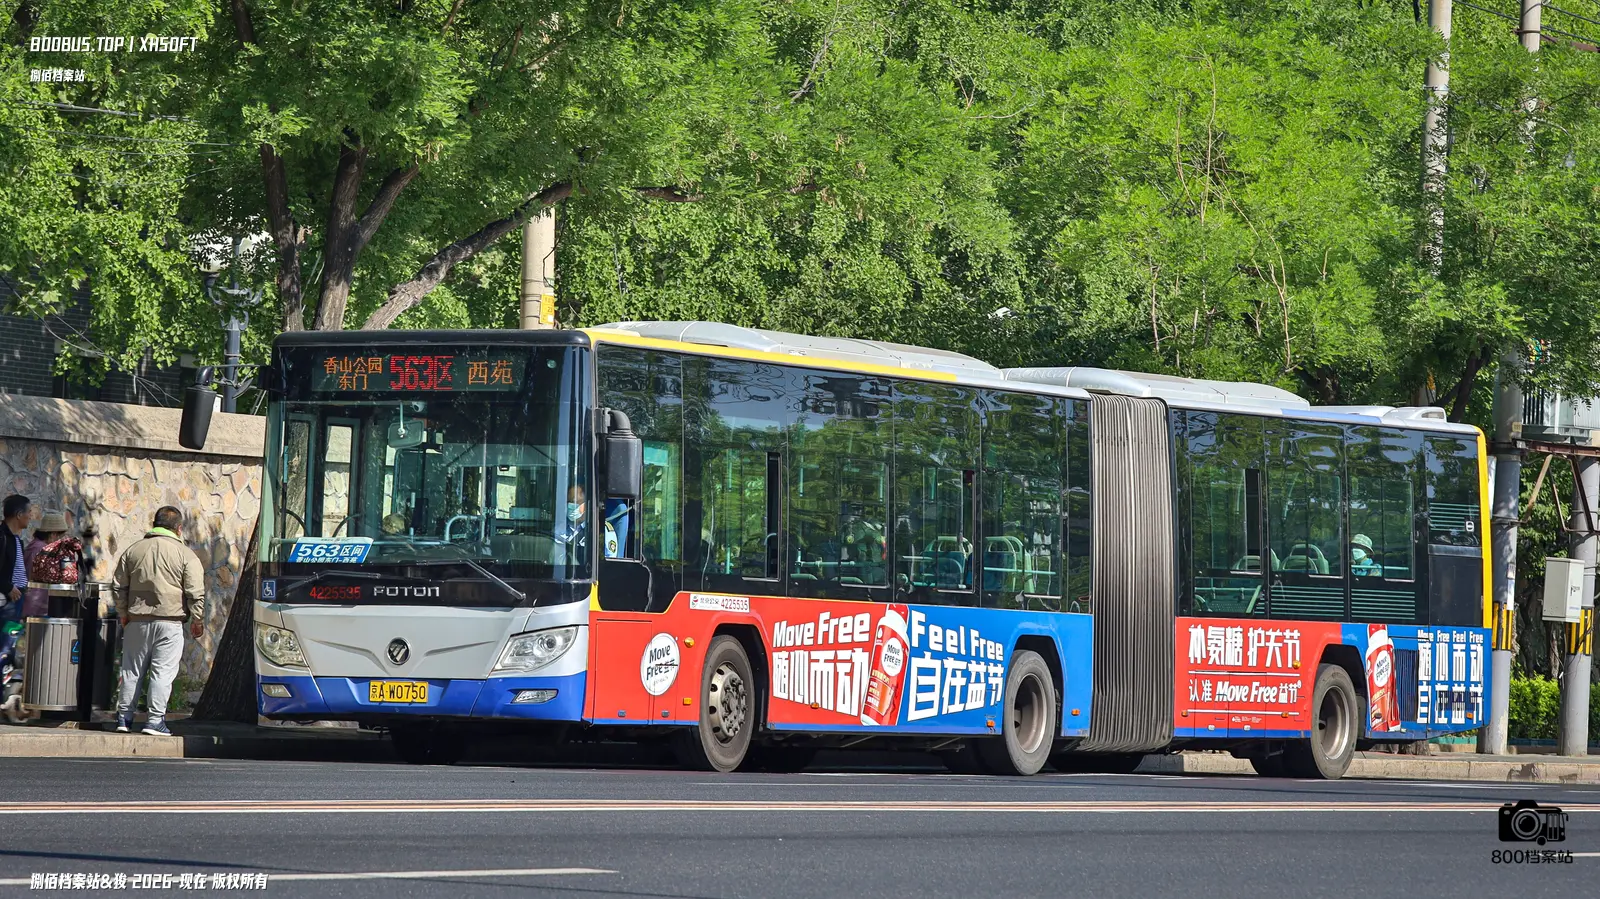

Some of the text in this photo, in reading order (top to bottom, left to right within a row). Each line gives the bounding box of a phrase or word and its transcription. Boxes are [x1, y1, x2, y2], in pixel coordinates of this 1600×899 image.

[323, 356, 383, 374] 香山公园
[389, 355, 513, 391] 563区 西苑
[338, 373, 368, 390] 东门
[297, 543, 365, 557] 563区间
[309, 586, 361, 599] 4225535
[373, 585, 440, 597] FOTON
[721, 598, 749, 611] 4225535
[773, 611, 870, 648] Move Free
[911, 610, 1004, 661] Feel Free
[1417, 629, 1483, 643] Move Free Feel Free
[649, 645, 671, 663] Move
[1247, 627, 1300, 668] 护关节
[646, 663, 663, 680] Free
[1417, 642, 1483, 682] 随心而动
[772, 647, 870, 717] 随心而动
[907, 651, 1004, 722] 自在益节
[1188, 679, 1213, 702] 认准
[1214, 681, 1249, 703] Move
[1250, 681, 1278, 703] Free
[1416, 681, 1483, 724] 自在益节
